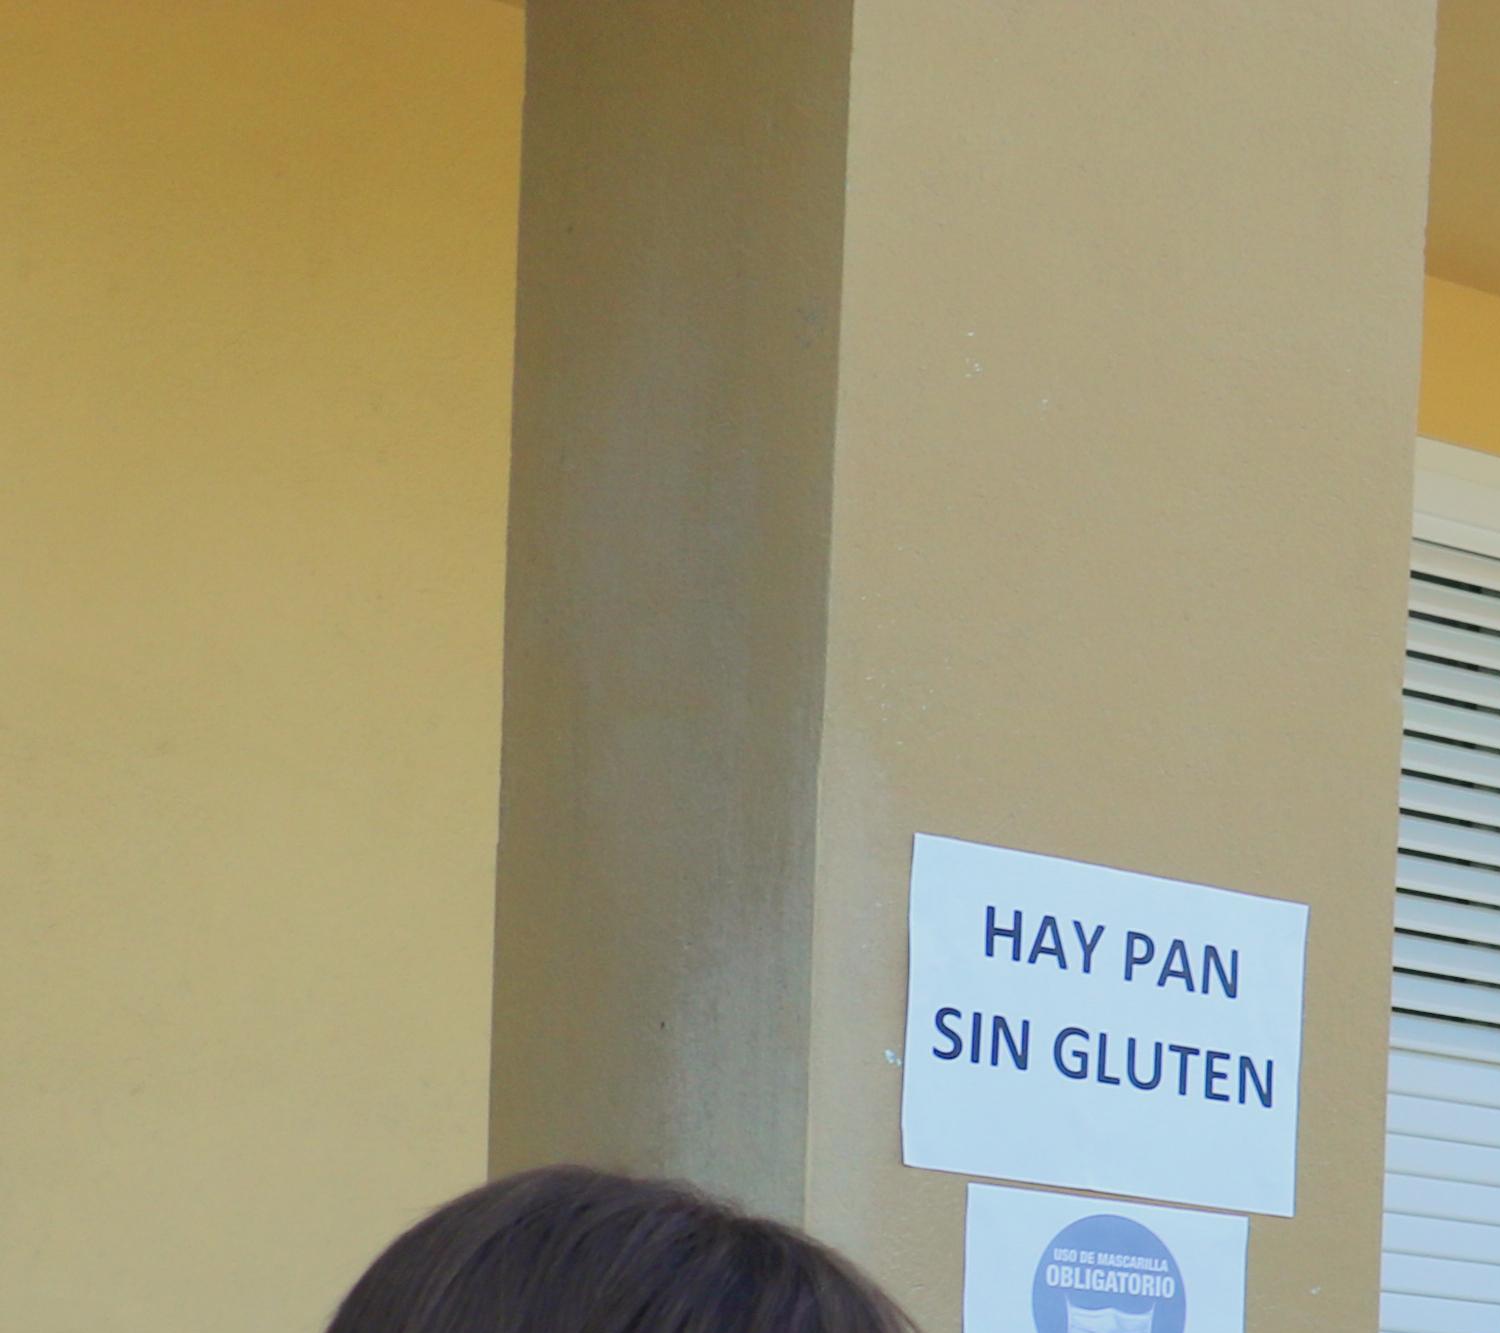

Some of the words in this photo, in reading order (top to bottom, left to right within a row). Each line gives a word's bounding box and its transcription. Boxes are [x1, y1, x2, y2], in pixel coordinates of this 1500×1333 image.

[984, 905, 1105, 974] HAY
[1124, 930, 1239, 999] PAN
[932, 1006, 1030, 1071] SIN
[1053, 1026, 1274, 1108] GLUTEN
[1046, 1264, 1175, 1298] OBLIGATORIO
[1053, 1248, 1077, 1263] USO
[1079, 1250, 1096, 1265] DE
[1097, 1251, 1169, 1273] MASCARILLA
